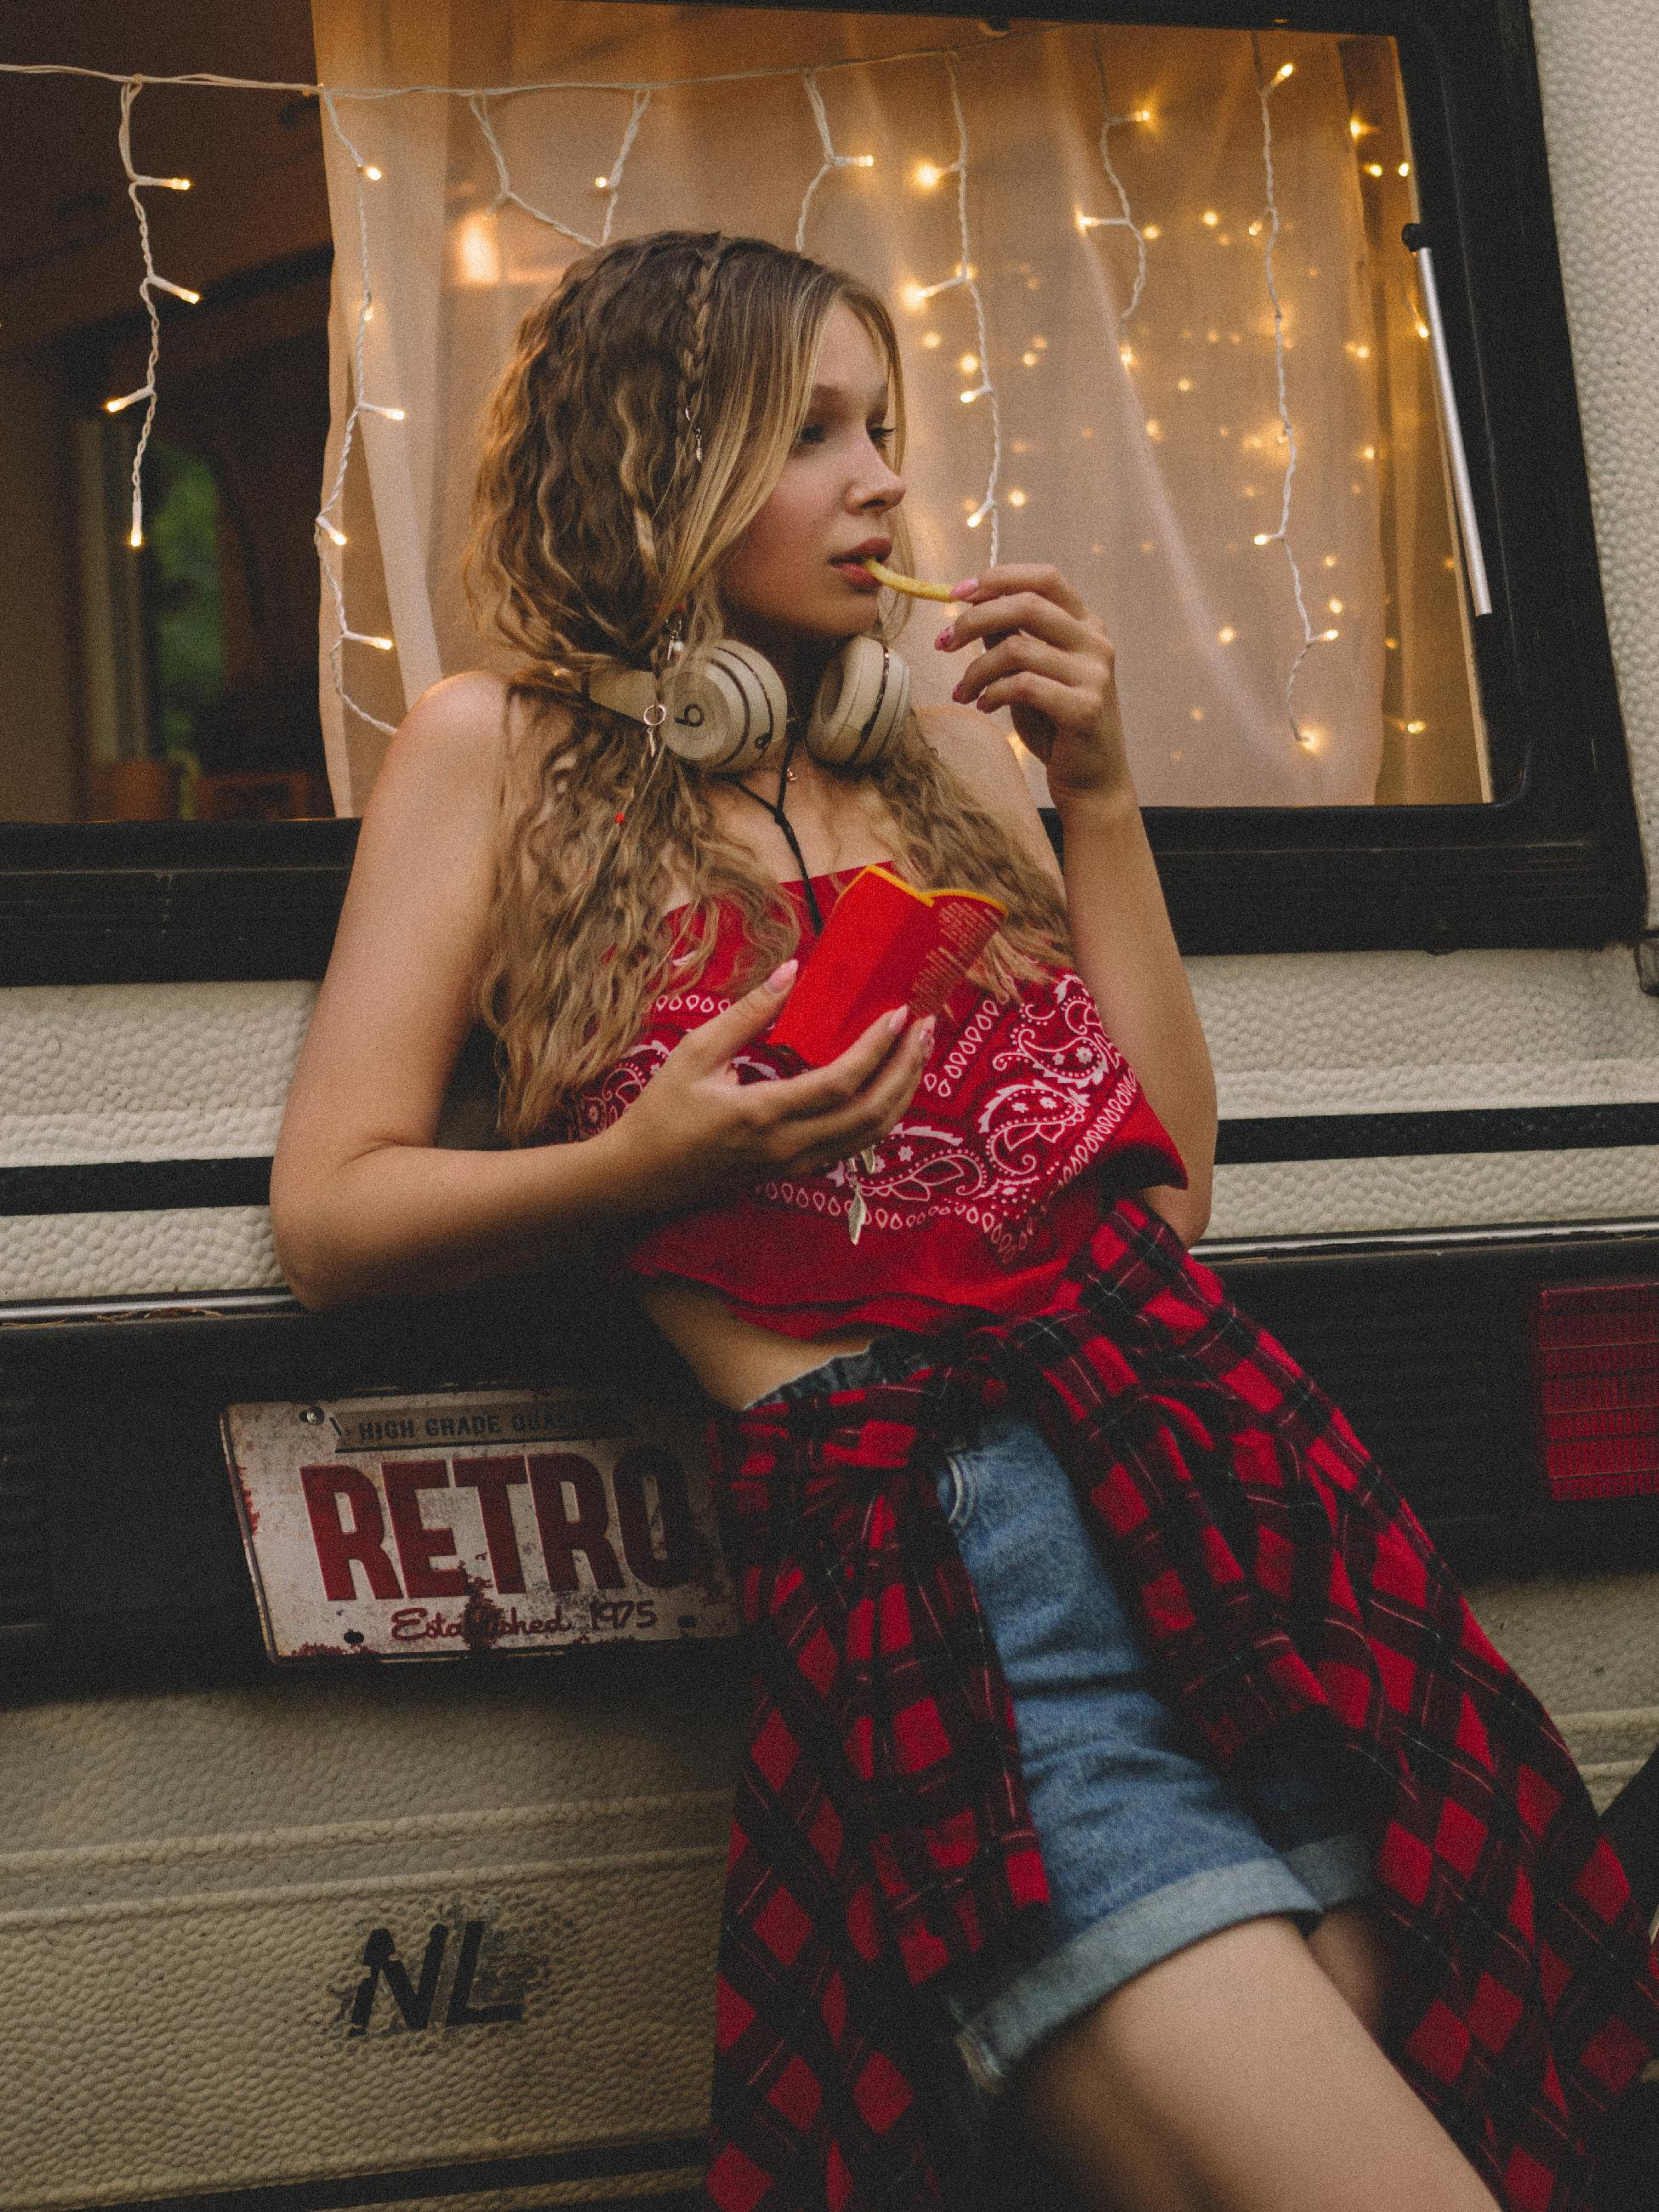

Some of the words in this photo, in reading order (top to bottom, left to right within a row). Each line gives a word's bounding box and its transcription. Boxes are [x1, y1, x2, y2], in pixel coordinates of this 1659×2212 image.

[358, 1418, 415, 1442] HIGH
[425, 1414, 500, 1437] GRADE
[299, 1445, 693, 1601] RETRO
[391, 1605, 573, 1642] Estashed
[590, 1599, 658, 1631] 1975
[347, 1919, 526, 2038] NL
